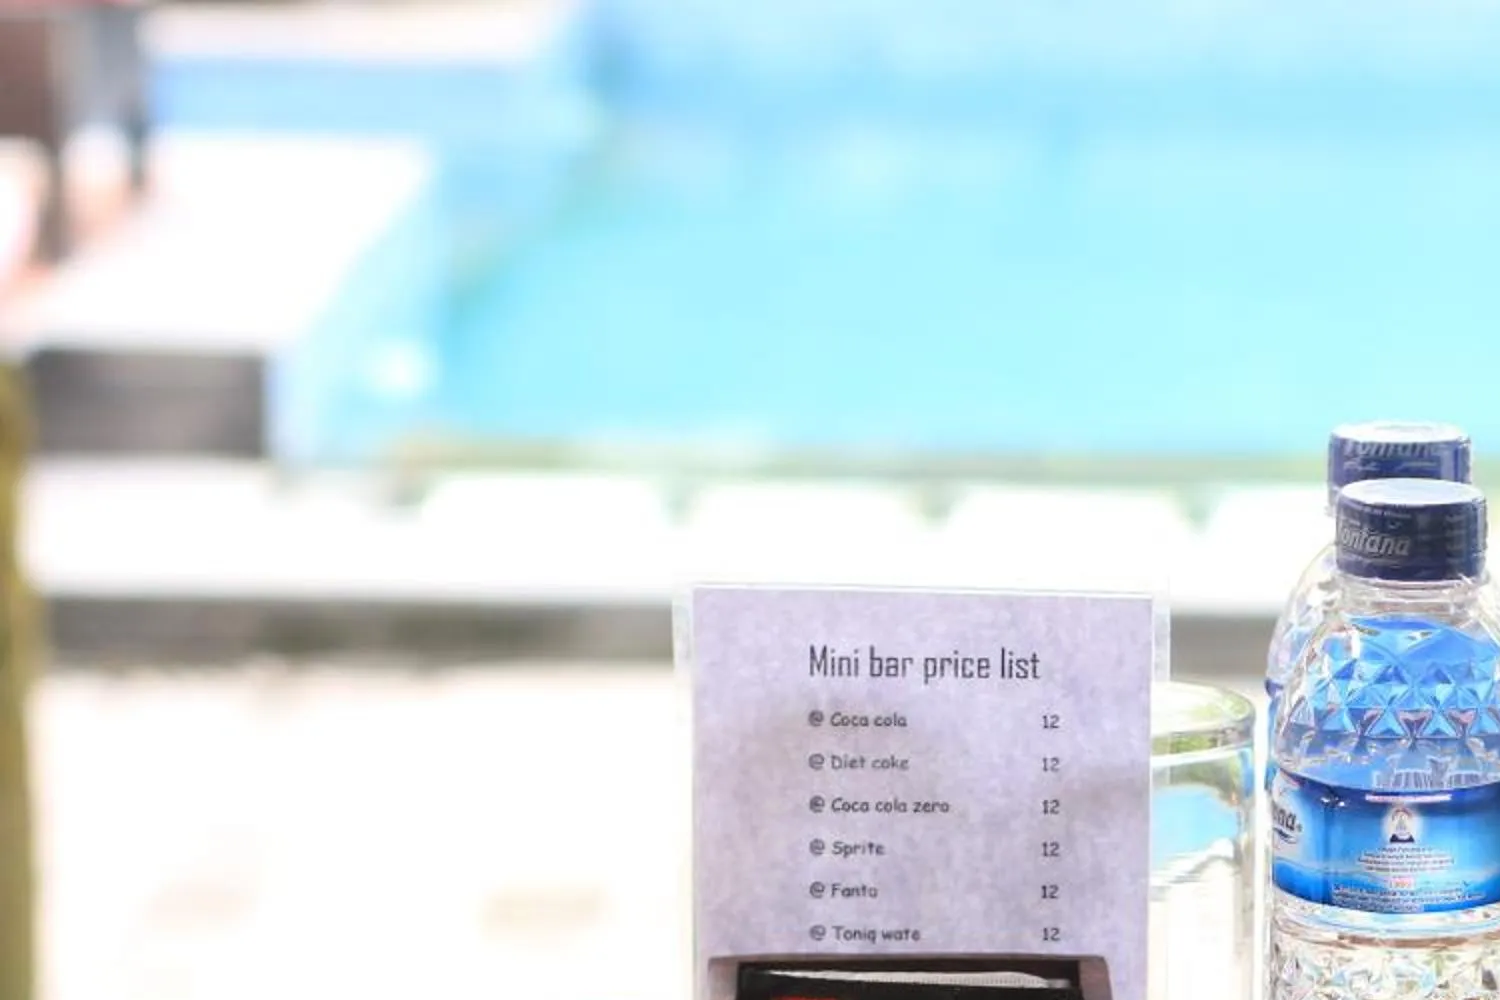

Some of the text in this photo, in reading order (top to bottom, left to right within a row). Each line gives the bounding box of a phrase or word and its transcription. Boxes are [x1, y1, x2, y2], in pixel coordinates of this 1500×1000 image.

[809, 643, 1041, 685] Mini bar price list
[830, 711, 870, 728] Coca
[873, 712, 909, 728] cola
[1042, 713, 1060, 729] 12
[830, 754, 866, 771] Diet
[871, 755, 910, 771] coke
[1042, 756, 1060, 772] 12
[830, 796, 870, 813] Coca
[874, 797, 908, 813] cola
[912, 801, 951, 814] zero
[1042, 799, 1060, 815] 12
[831, 840, 885, 859] Sprite
[1041, 841, 1060, 857] 12
[830, 882, 879, 899] Fanta
[1041, 884, 1060, 900] 12
[881, 927, 921, 942] wate
[1042, 927, 1061, 942] 12
